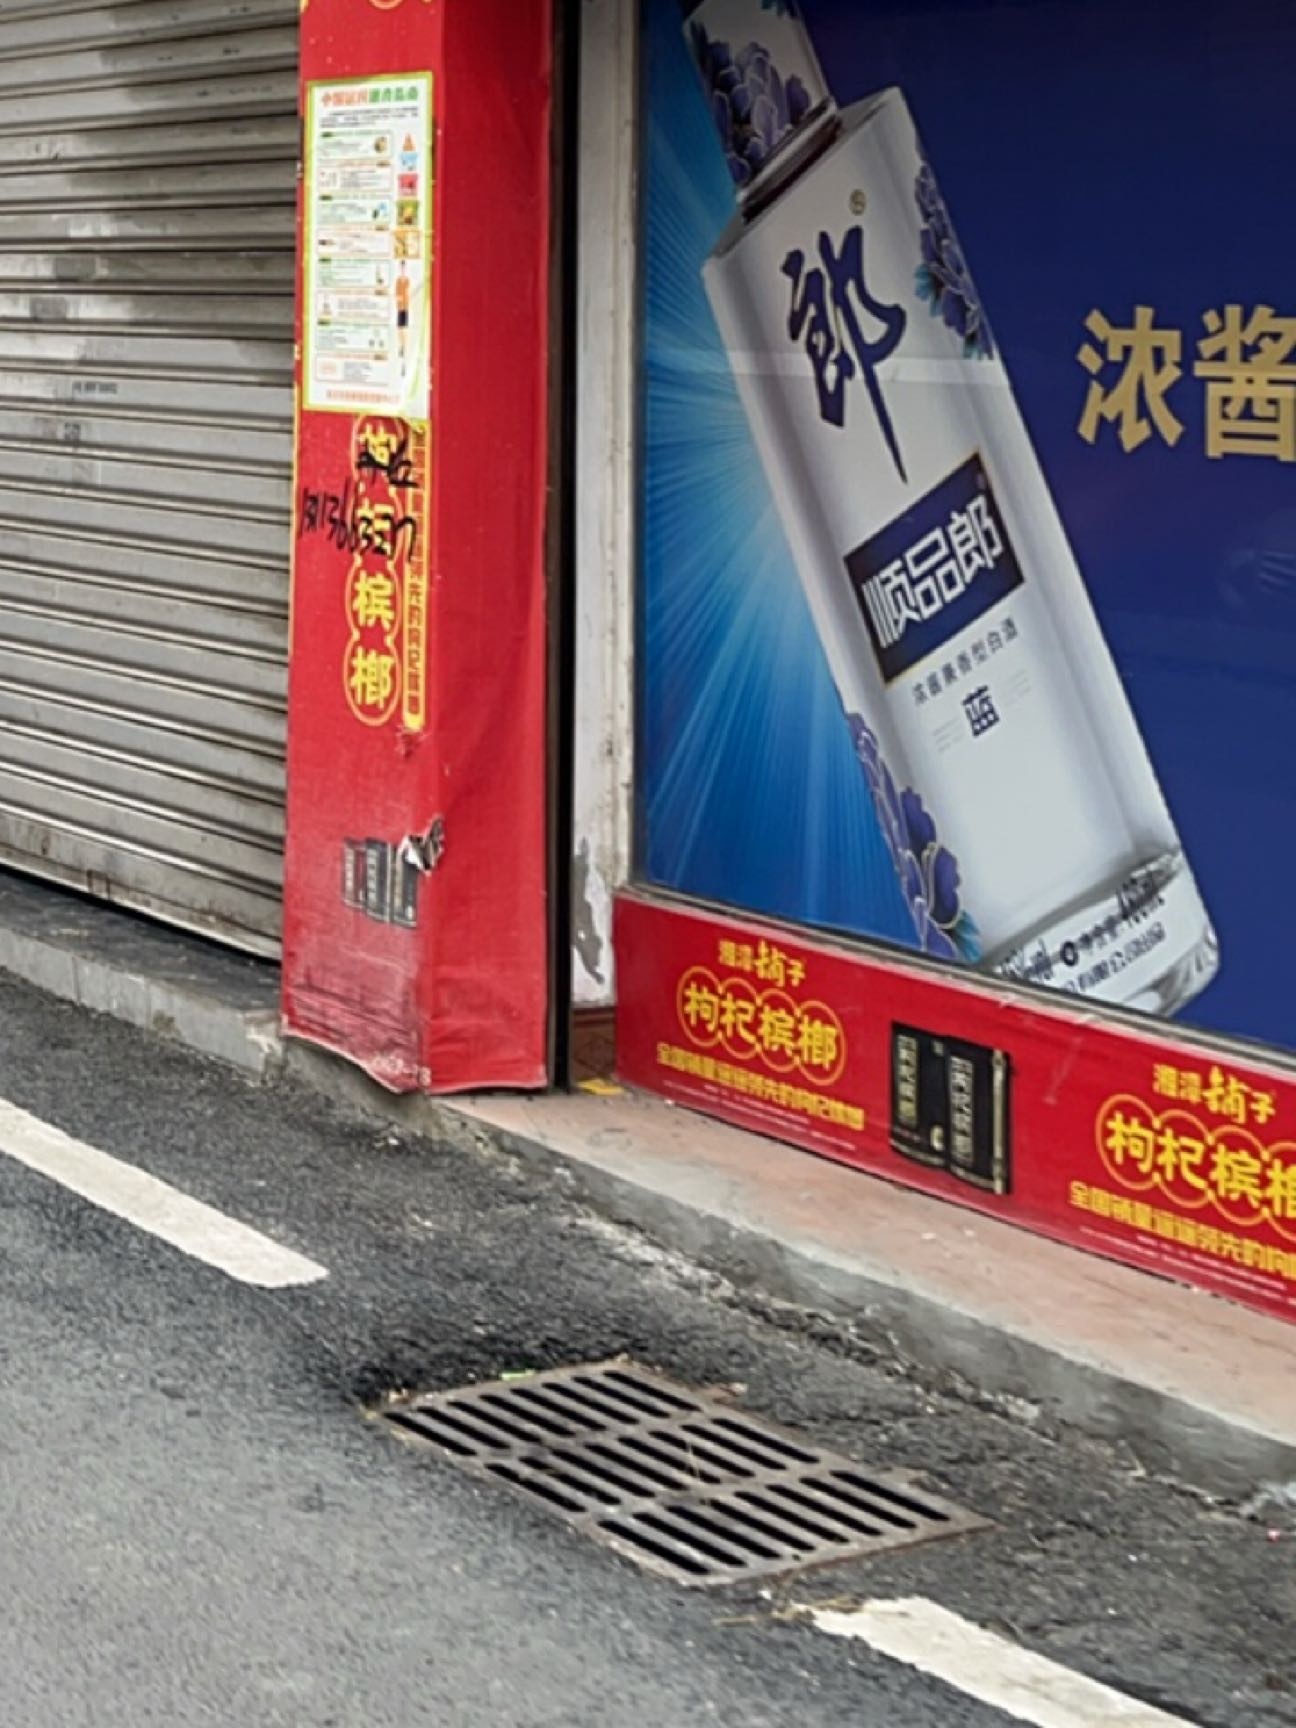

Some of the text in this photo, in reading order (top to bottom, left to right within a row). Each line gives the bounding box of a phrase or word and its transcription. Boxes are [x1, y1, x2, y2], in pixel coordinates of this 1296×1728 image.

[860, 494, 1004, 650] 顺品郎
[683, 981, 838, 1072] 枸杞槟榔
